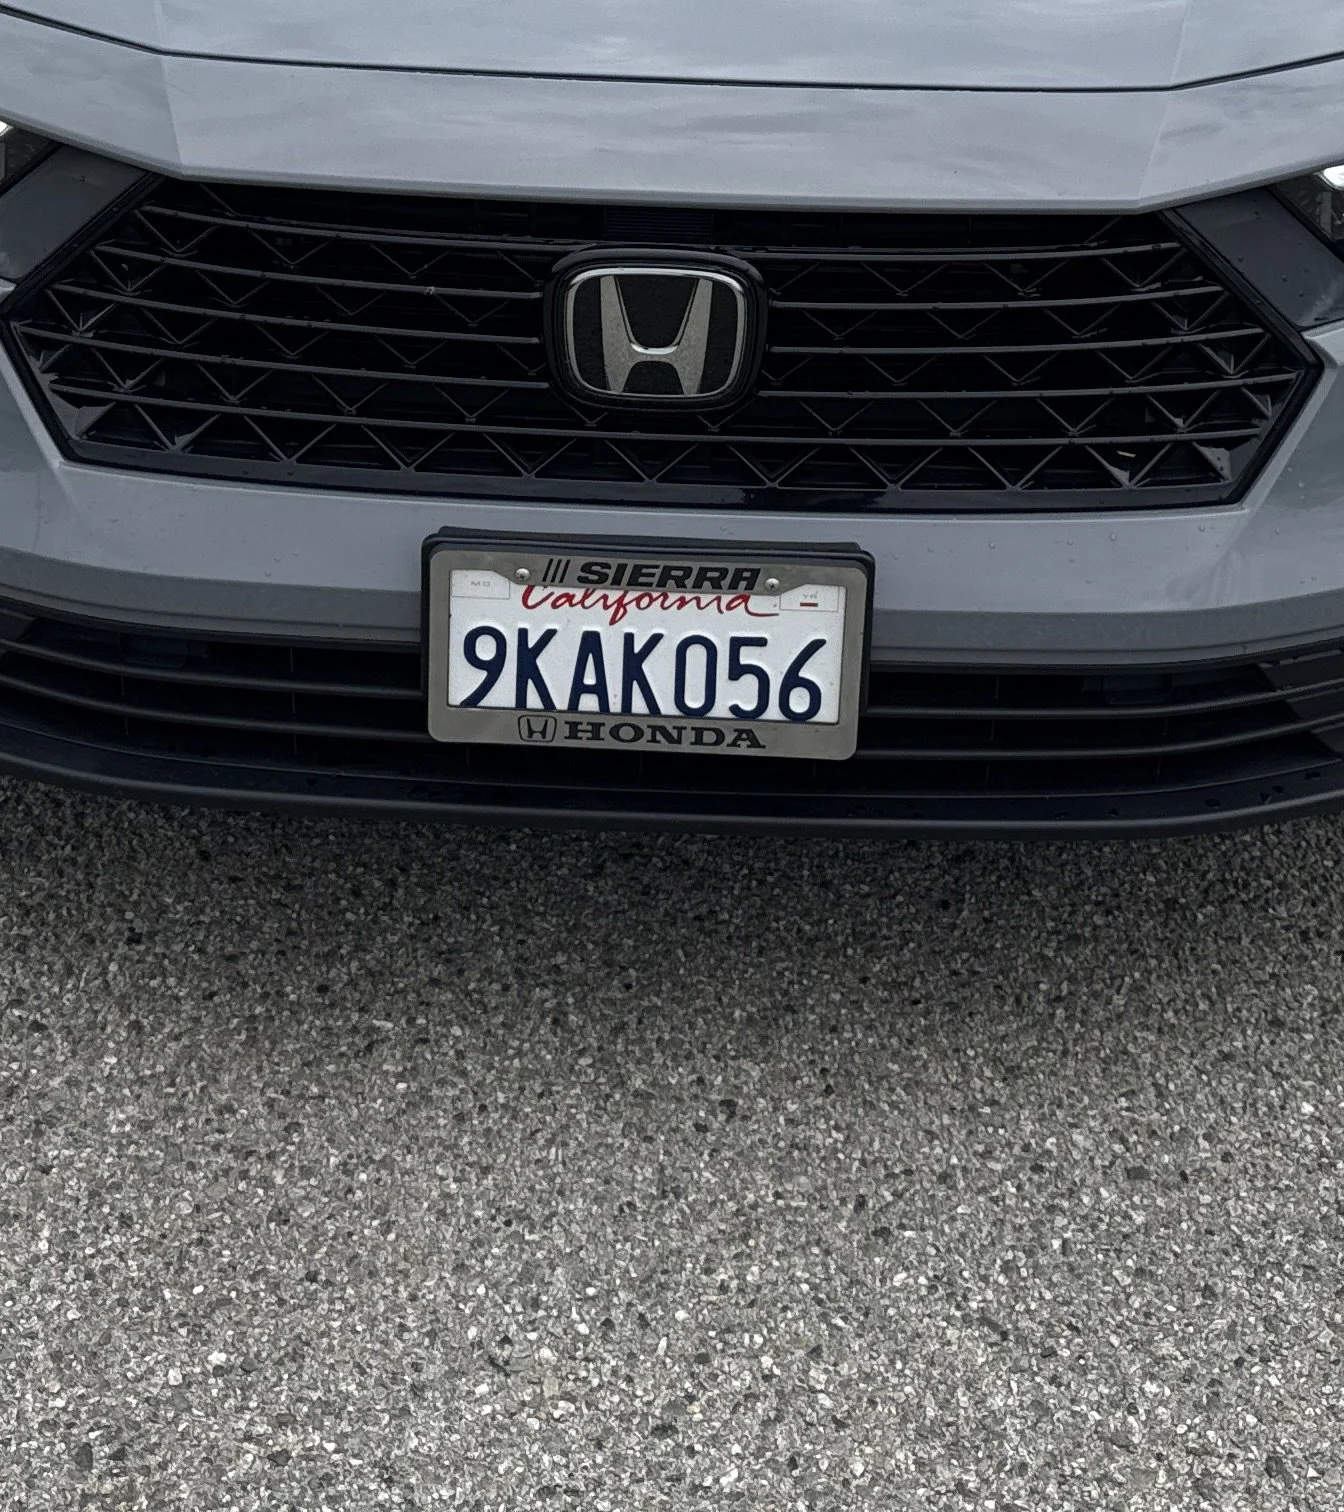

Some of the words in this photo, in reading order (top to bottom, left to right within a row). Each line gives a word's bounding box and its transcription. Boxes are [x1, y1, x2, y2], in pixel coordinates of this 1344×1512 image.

[576, 561, 761, 591] SIERRA
[521, 585, 779, 625] California
[459, 625, 827, 722] 9KAK056
[564, 720, 766, 749] HONDA
